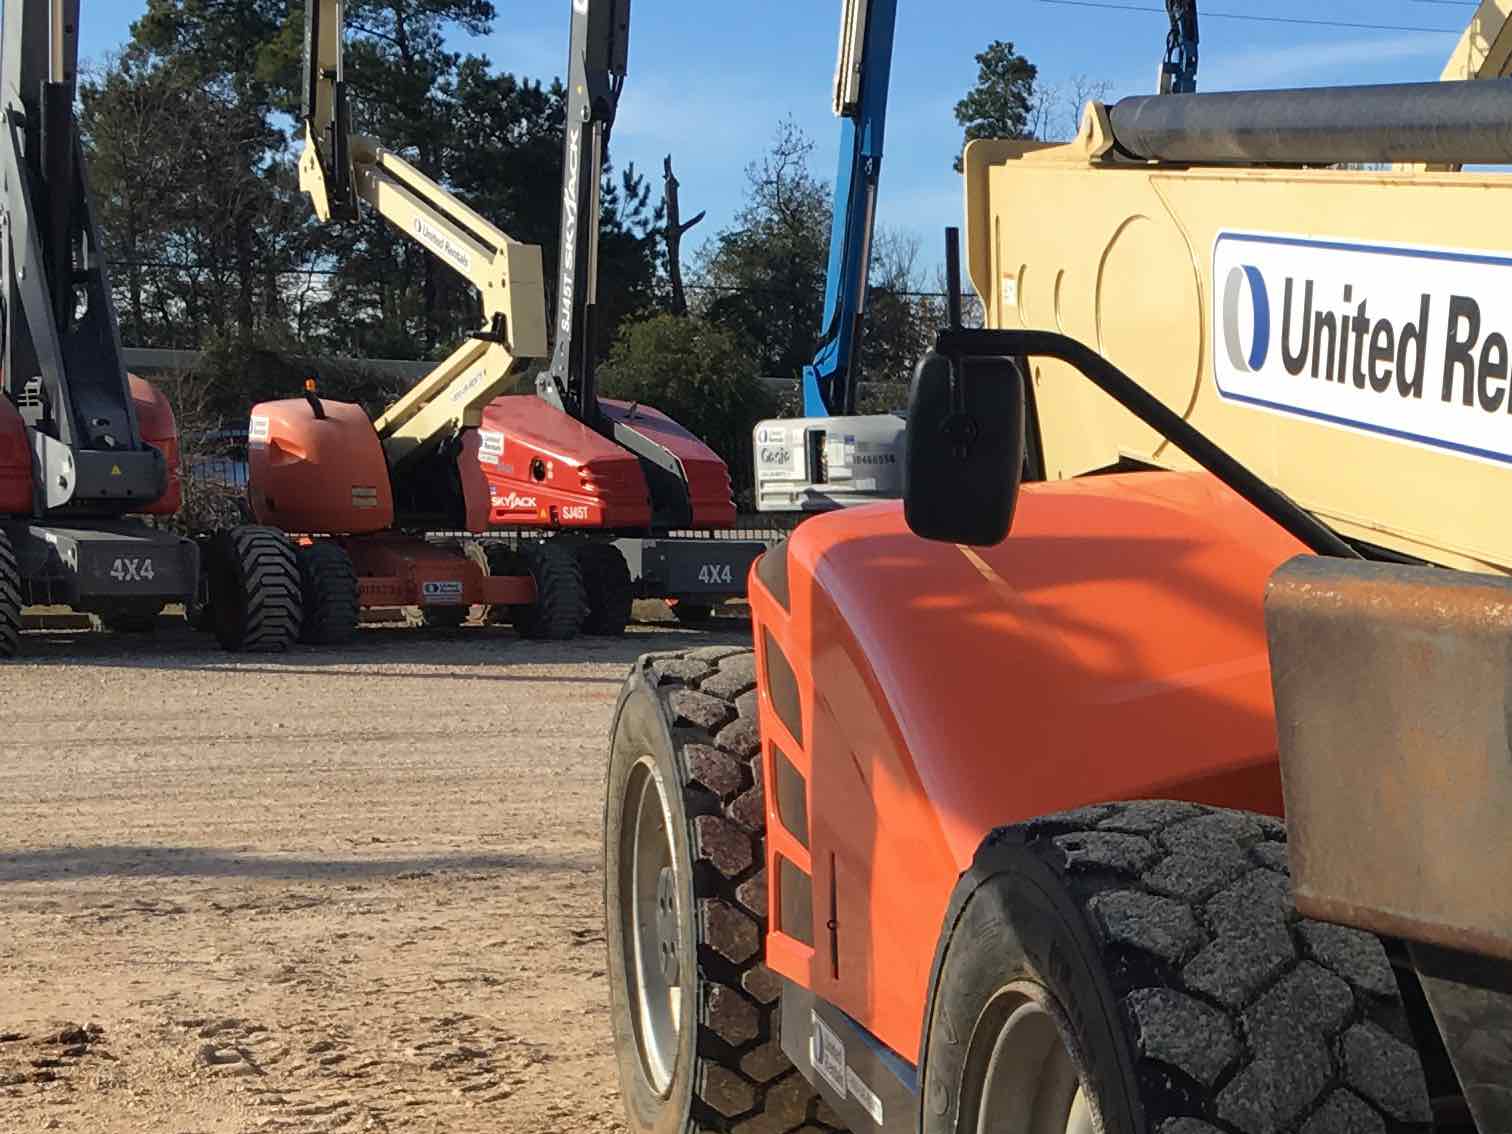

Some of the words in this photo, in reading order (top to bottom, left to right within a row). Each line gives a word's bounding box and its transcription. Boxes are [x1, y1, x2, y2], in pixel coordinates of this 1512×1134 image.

[1281, 276, 1431, 399] United
[490, 492, 537, 508] SKYJACK
[562, 505, 589, 519] SJ45T
[110, 558, 154, 581] 4X4
[698, 564, 732, 583] 4X4
